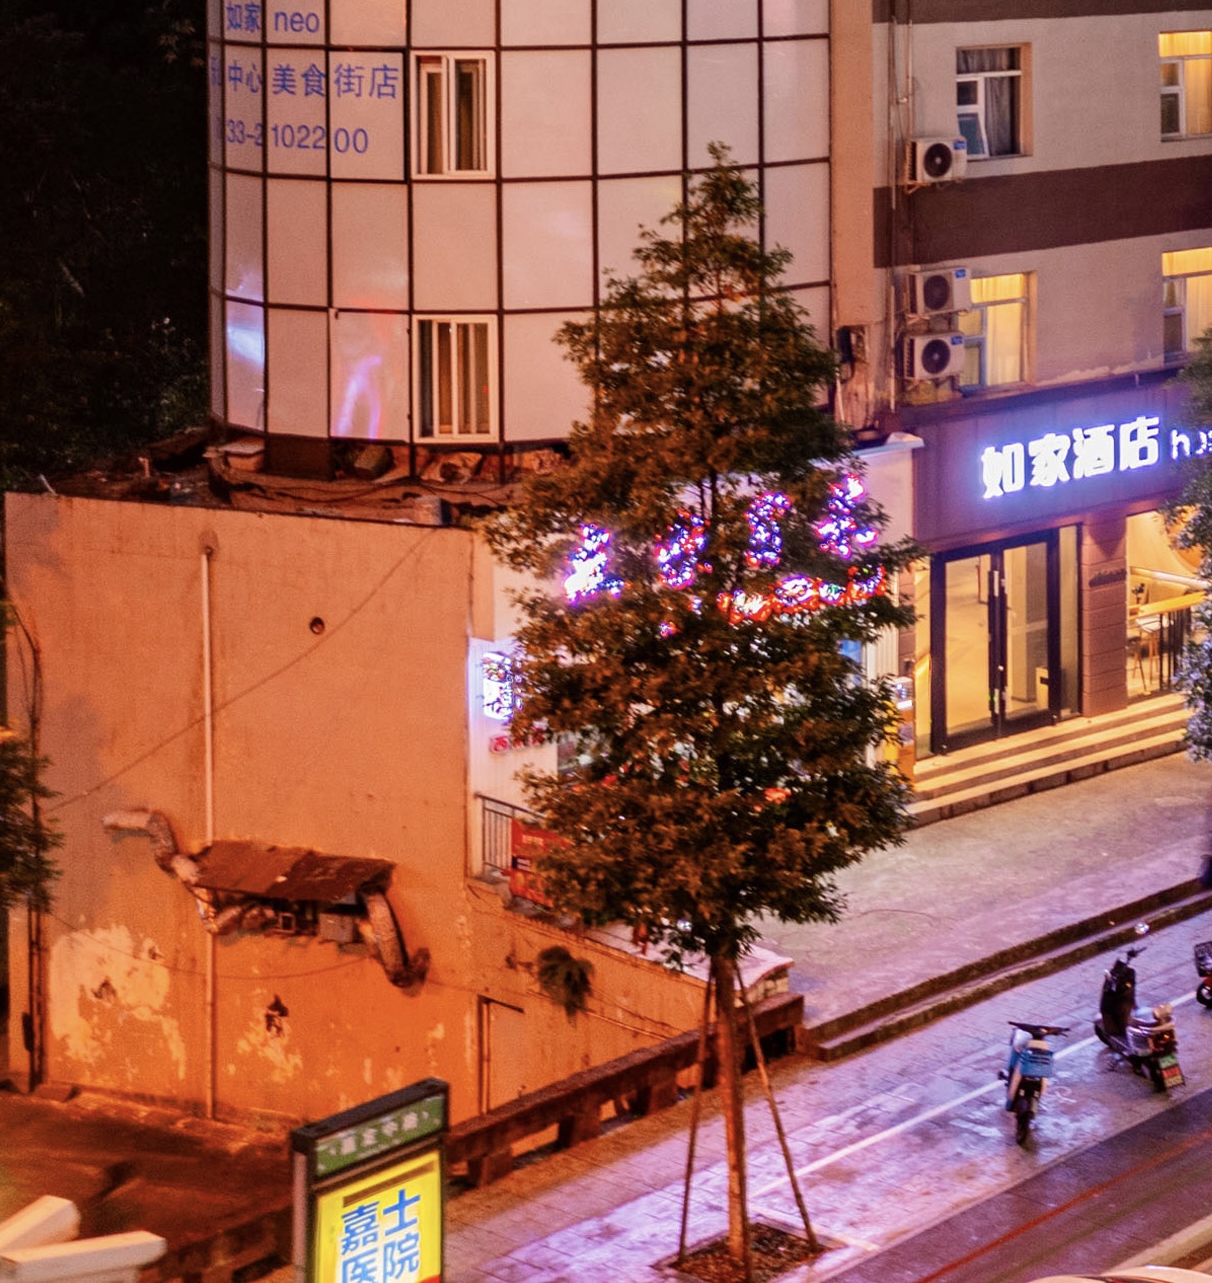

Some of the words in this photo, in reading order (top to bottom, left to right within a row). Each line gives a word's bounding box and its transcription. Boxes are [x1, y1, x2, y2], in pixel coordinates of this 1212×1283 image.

[226, 1, 262, 33] 如家
[274, 10, 320, 34] neo
[210, 55, 398, 99] 中心美食街店
[981, 416, 1160, 500] 如家酒店
[341, 1188, 421, 1255] 嘉士
[341, 1232, 420, 1283] 医院
